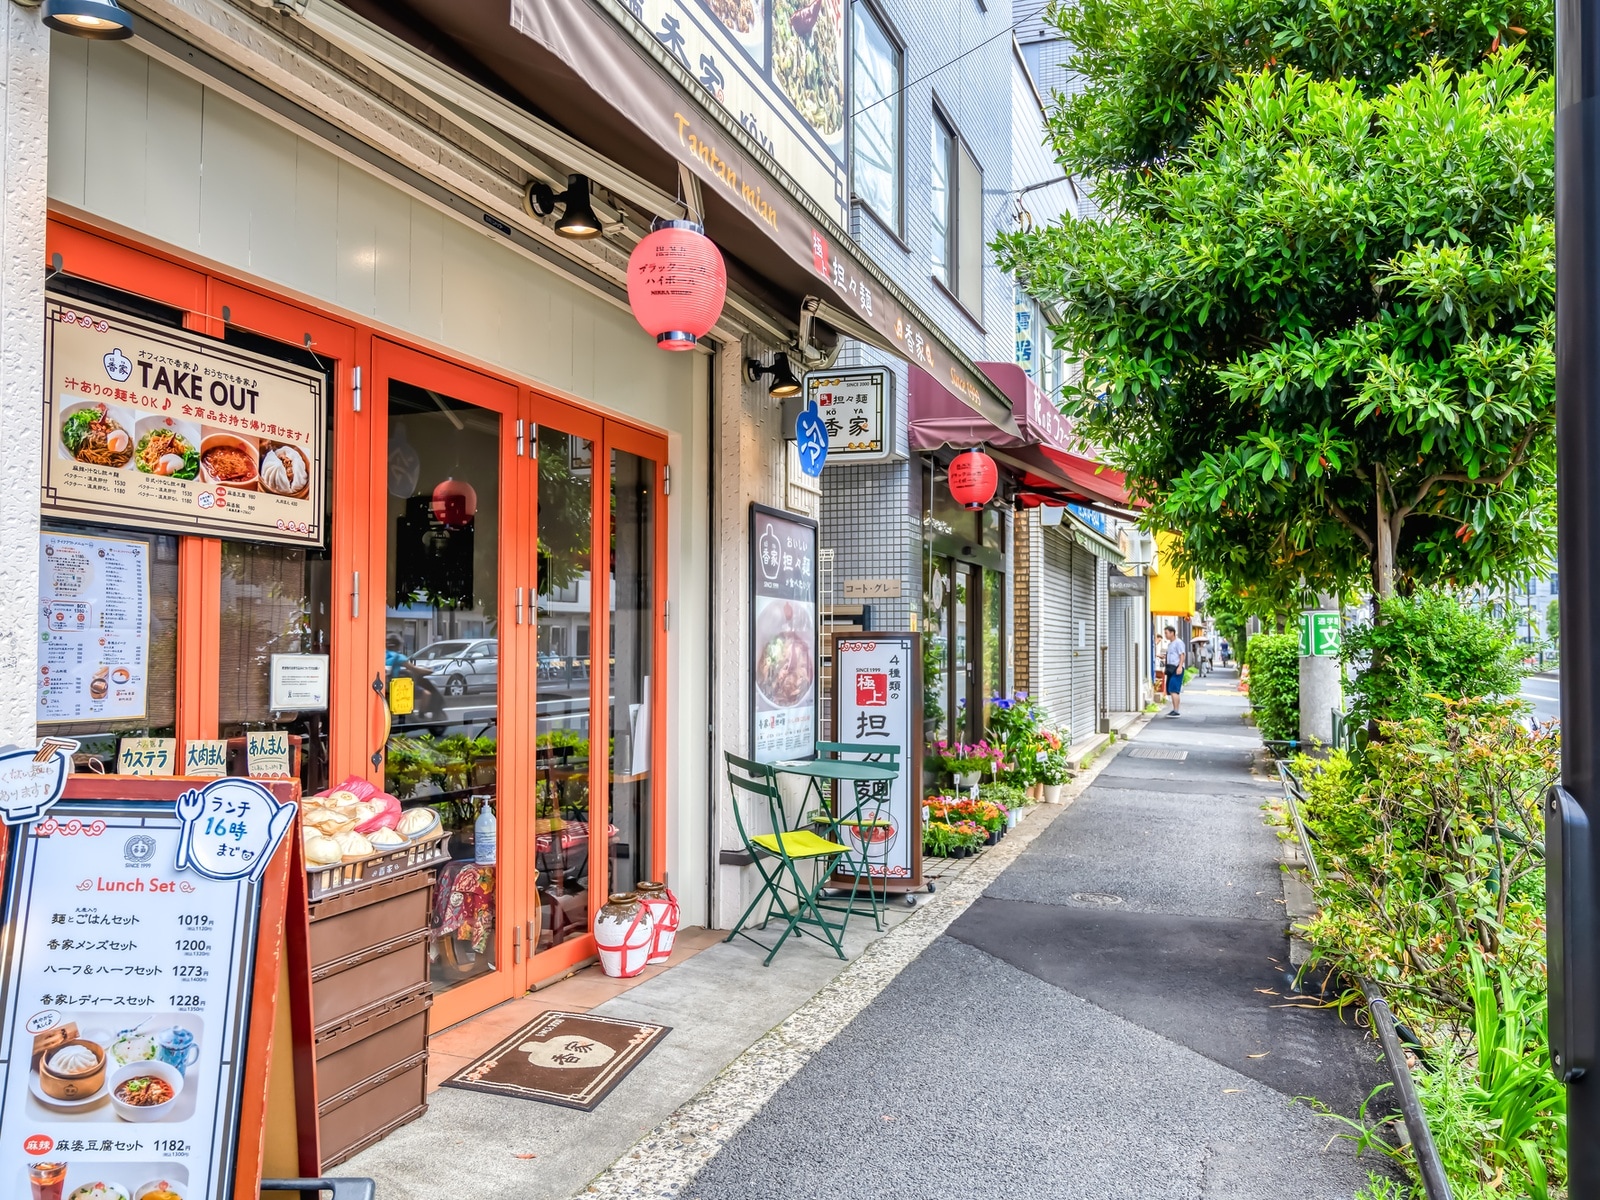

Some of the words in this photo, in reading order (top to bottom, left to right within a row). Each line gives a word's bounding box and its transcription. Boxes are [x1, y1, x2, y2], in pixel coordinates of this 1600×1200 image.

[673, 112, 740, 196] Tantan
[741, 180, 779, 233] mian
[812, 233, 831, 282] 極上
[832, 255, 873, 317] 担々麺
[904, 323, 927, 362] 香家
[137, 360, 203, 402] TAKE
[209, 380, 260, 414] OUT
[833, 393, 868, 406] 担々麺
[824, 415, 869, 437] 香家
[800, 420, 826, 466] 冷
[786, 535, 808, 552] おいしい
[762, 548, 779, 567] 香家
[782, 552, 811, 577] 担々麺
[846, 583, 899, 594] コート・グレー
[889, 654, 901, 700] 4種類の
[856, 674, 887, 705] 極上
[187, 743, 226, 767] 大肉まん
[248, 734, 287, 757] あんまん
[121, 747, 168, 769] カステラ
[211, 796, 251, 818] ランチ
[204, 816, 248, 841] 16時
[216, 843, 241, 857] まで
[97, 877, 145, 893] Lunch
[149, 877, 176, 893] Set
[51, 913, 140, 926] 麺とごはんセット
[47, 938, 138, 951] 香家メンズセット
[40, 993, 155, 1006] 香家レディースセット
[551, 1040, 595, 1066] 香家
[25, 1139, 52, 1151] 麻辣
[55, 1139, 144, 1152] 麻婆豆腐セット
